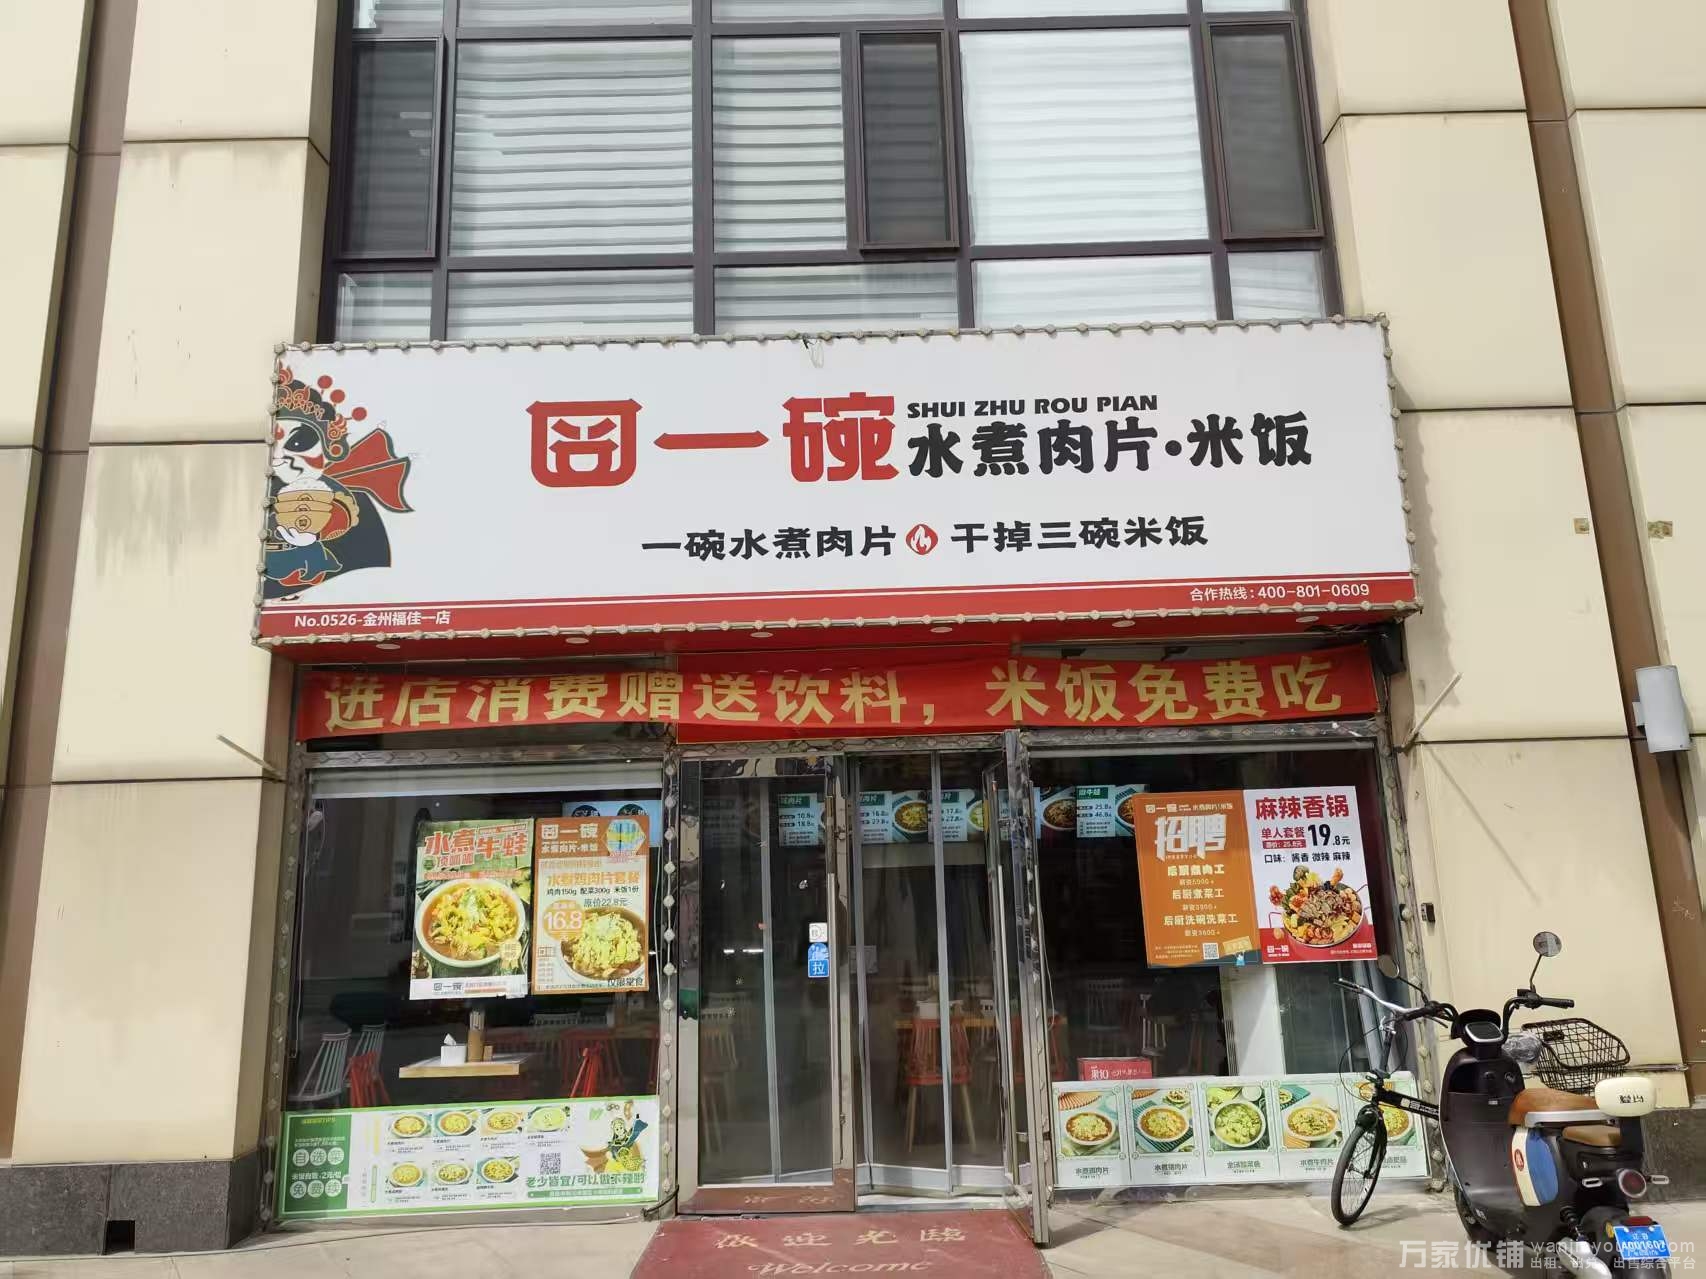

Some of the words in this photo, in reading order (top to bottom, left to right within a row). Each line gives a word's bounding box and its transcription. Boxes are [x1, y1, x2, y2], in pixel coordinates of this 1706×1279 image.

[907, 402, 965, 418] SHUI
[974, 400, 1025, 416] ZHU
[1034, 397, 1087, 414] ROU
[1096, 395, 1158, 412] PIAN
[642, 525, 897, 562] 一碗水煮肉片
[951, 515, 1208, 553] 干掉三碗米饭
[985, 656, 1343, 725] 米饭免费吃
[1255, 795, 1350, 820] 麻辣香锅
[1154, 814, 1228, 862] 招聘
[1261, 827, 1305, 839] 单人套餐
[1311, 852, 1330, 862] 微辣
[1332, 851, 1351, 861] 麻辣
[546, 911, 583, 930] 16.8
[812, 962, 826, 976] 拉
